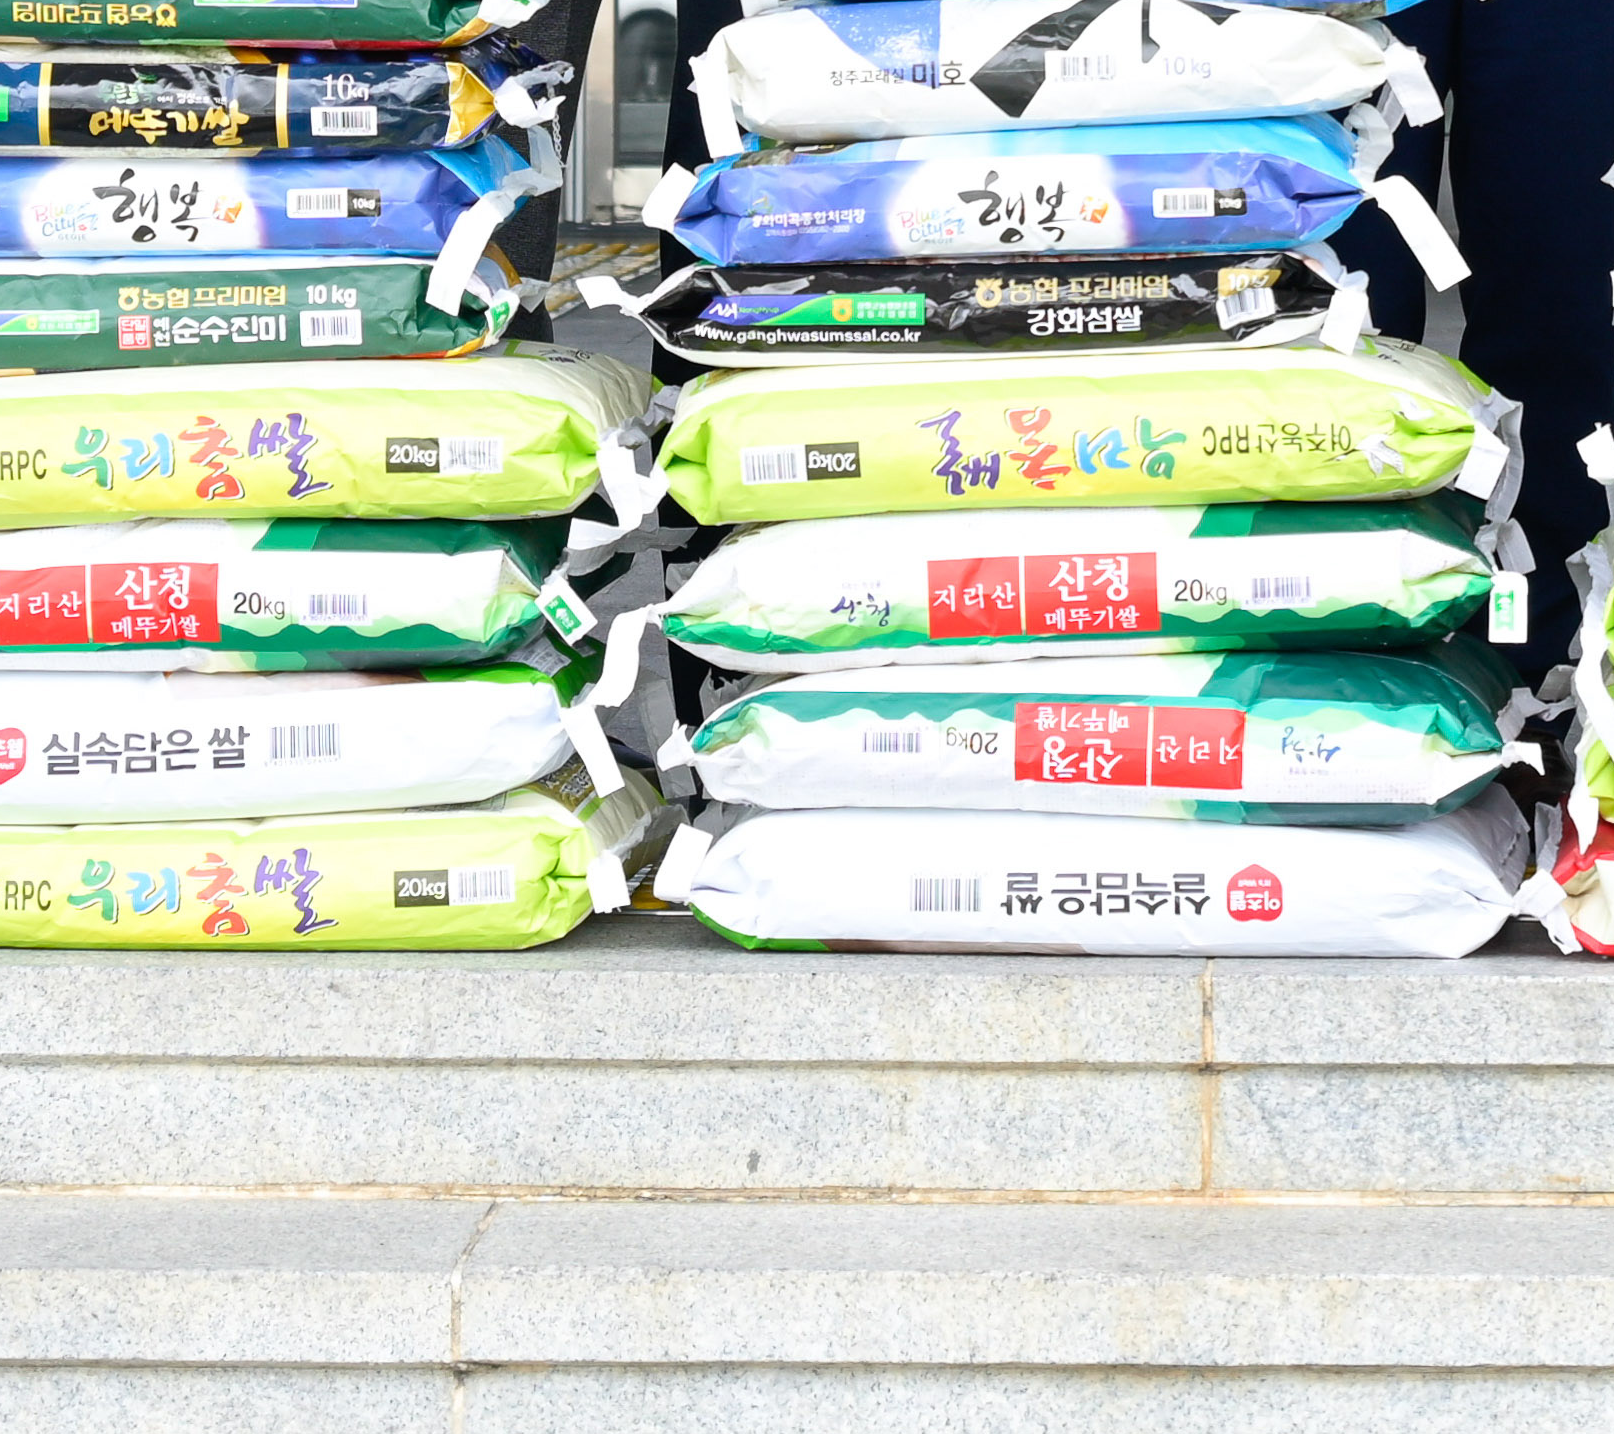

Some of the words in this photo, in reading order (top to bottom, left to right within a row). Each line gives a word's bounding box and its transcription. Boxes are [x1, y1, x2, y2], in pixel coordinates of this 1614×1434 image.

[12, 1, 102, 24] 프리미엄
[829, 67, 906, 89] 청주고래실
[94, 169, 212, 243] 행복
[959, 171, 1071, 244] 행복
[195, 283, 287, 307] 프리미엄
[306, 285, 329, 305] 10
[171, 313, 288, 344] 순수진미
[694, 323, 922, 347] www.ganghwasumssal.co.kr
[1027, 305, 1144, 335] 강화섬쌀
[0, 450, 48, 481] RPC
[389, 442, 438, 468] 20kg
[114, 564, 193, 612] 산청
[1047, 554, 1131, 603] 산청
[233, 591, 287, 620] 20kg
[931, 580, 1017, 612] 지리산
[112, 613, 201, 639] 메뚜기쌀
[1044, 603, 1139, 631] 메뚜기쌀
[42, 728, 202, 776] 실속담은
[207, 725, 251, 770] 쌀
[1155, 733, 1241, 766] 지리산
[7, 880, 52, 910] RPC
[397, 875, 447, 901] 20kg
[1001, 872, 1043, 917] 쌀
[1051, 872, 1212, 917] 실속담은
